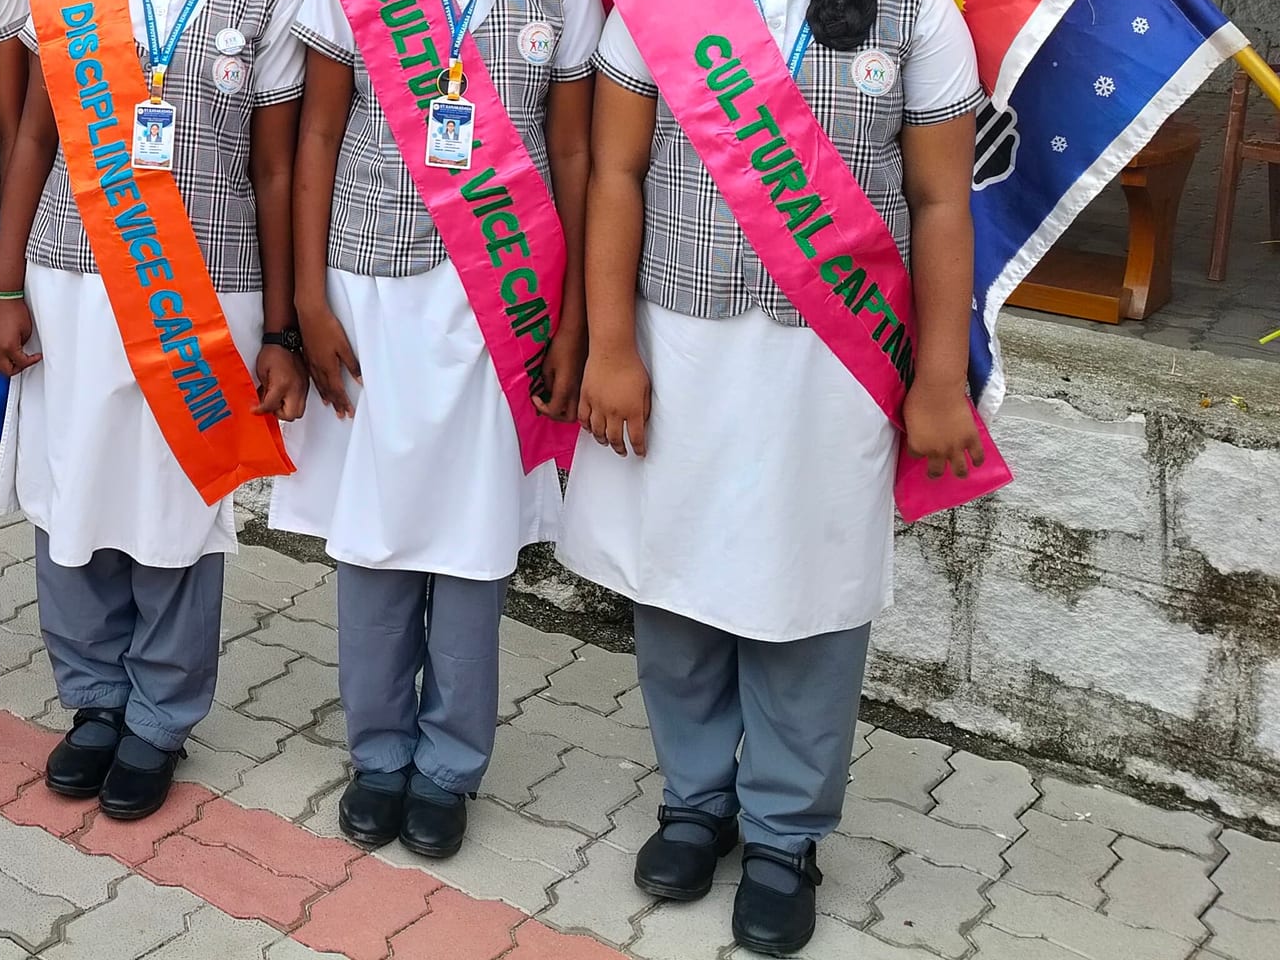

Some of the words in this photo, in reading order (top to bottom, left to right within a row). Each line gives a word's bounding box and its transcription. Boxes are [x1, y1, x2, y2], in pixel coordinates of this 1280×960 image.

[60, 1, 141, 208] DISCIPLINE
[114, 202, 174, 287] VICE
[148, 289, 233, 433] CAPTAIN
[460, 168, 531, 269] VICE
[693, 34, 834, 260] CULTURAL
